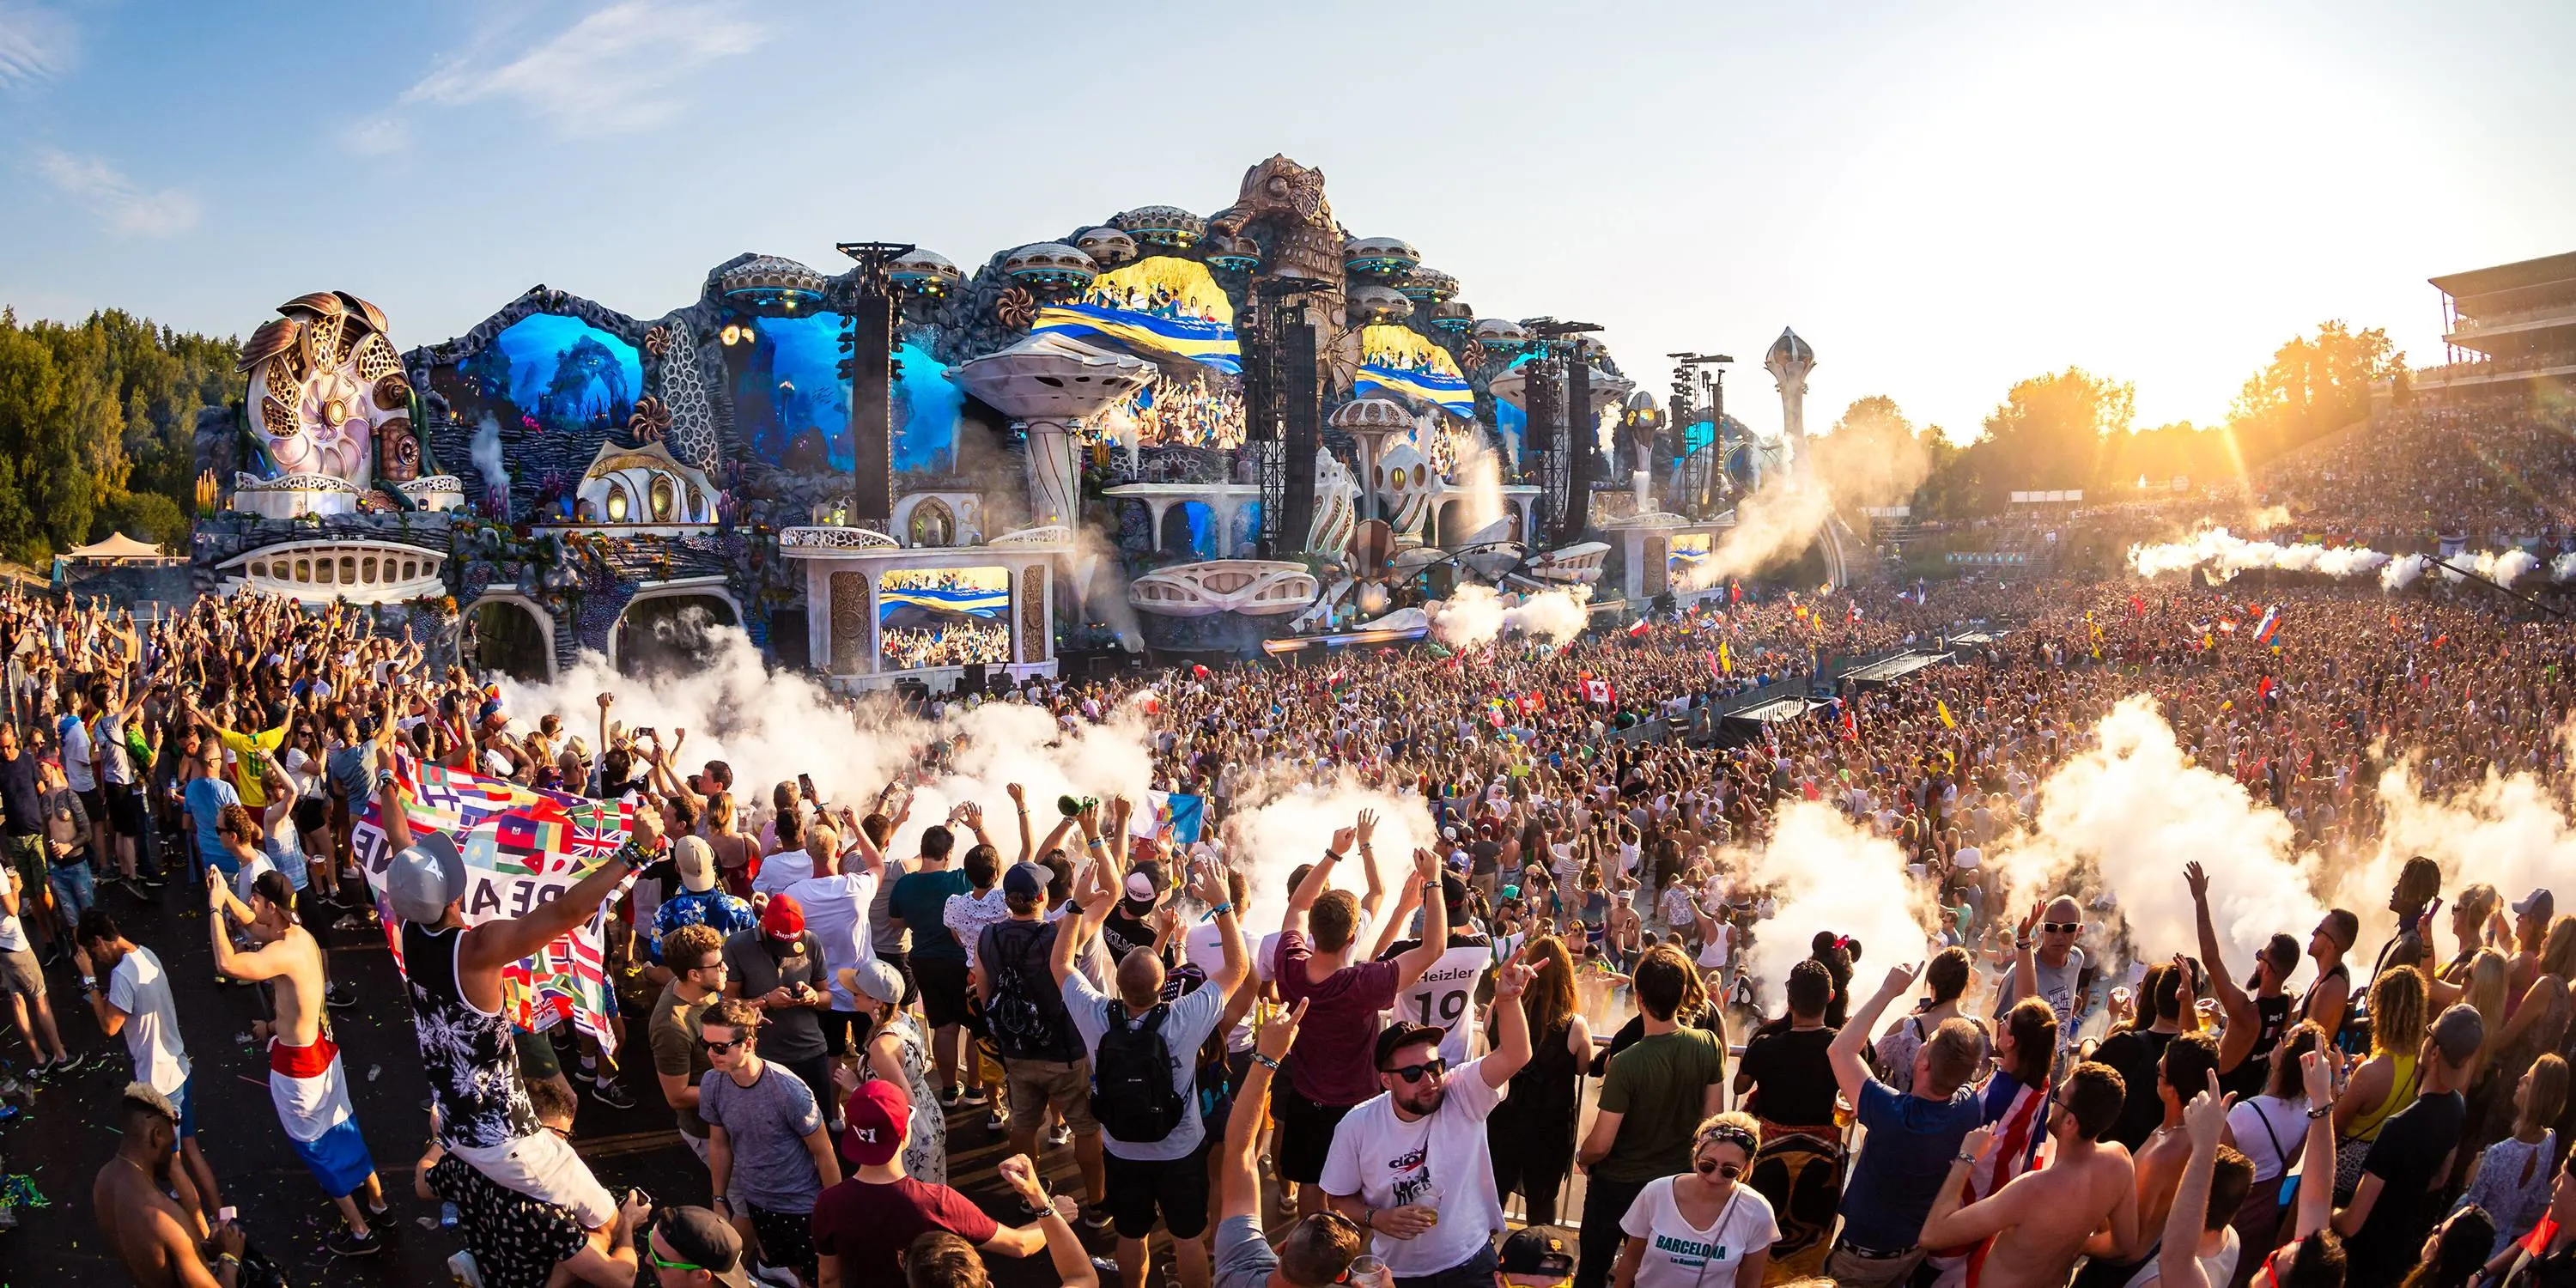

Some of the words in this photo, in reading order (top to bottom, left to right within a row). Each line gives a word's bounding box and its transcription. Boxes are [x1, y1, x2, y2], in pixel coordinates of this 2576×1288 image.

[1417, 968, 1474, 982] Heizler
[1415, 990, 1468, 1033] 19
[1656, 1235, 1726, 1260] BARCELONA
